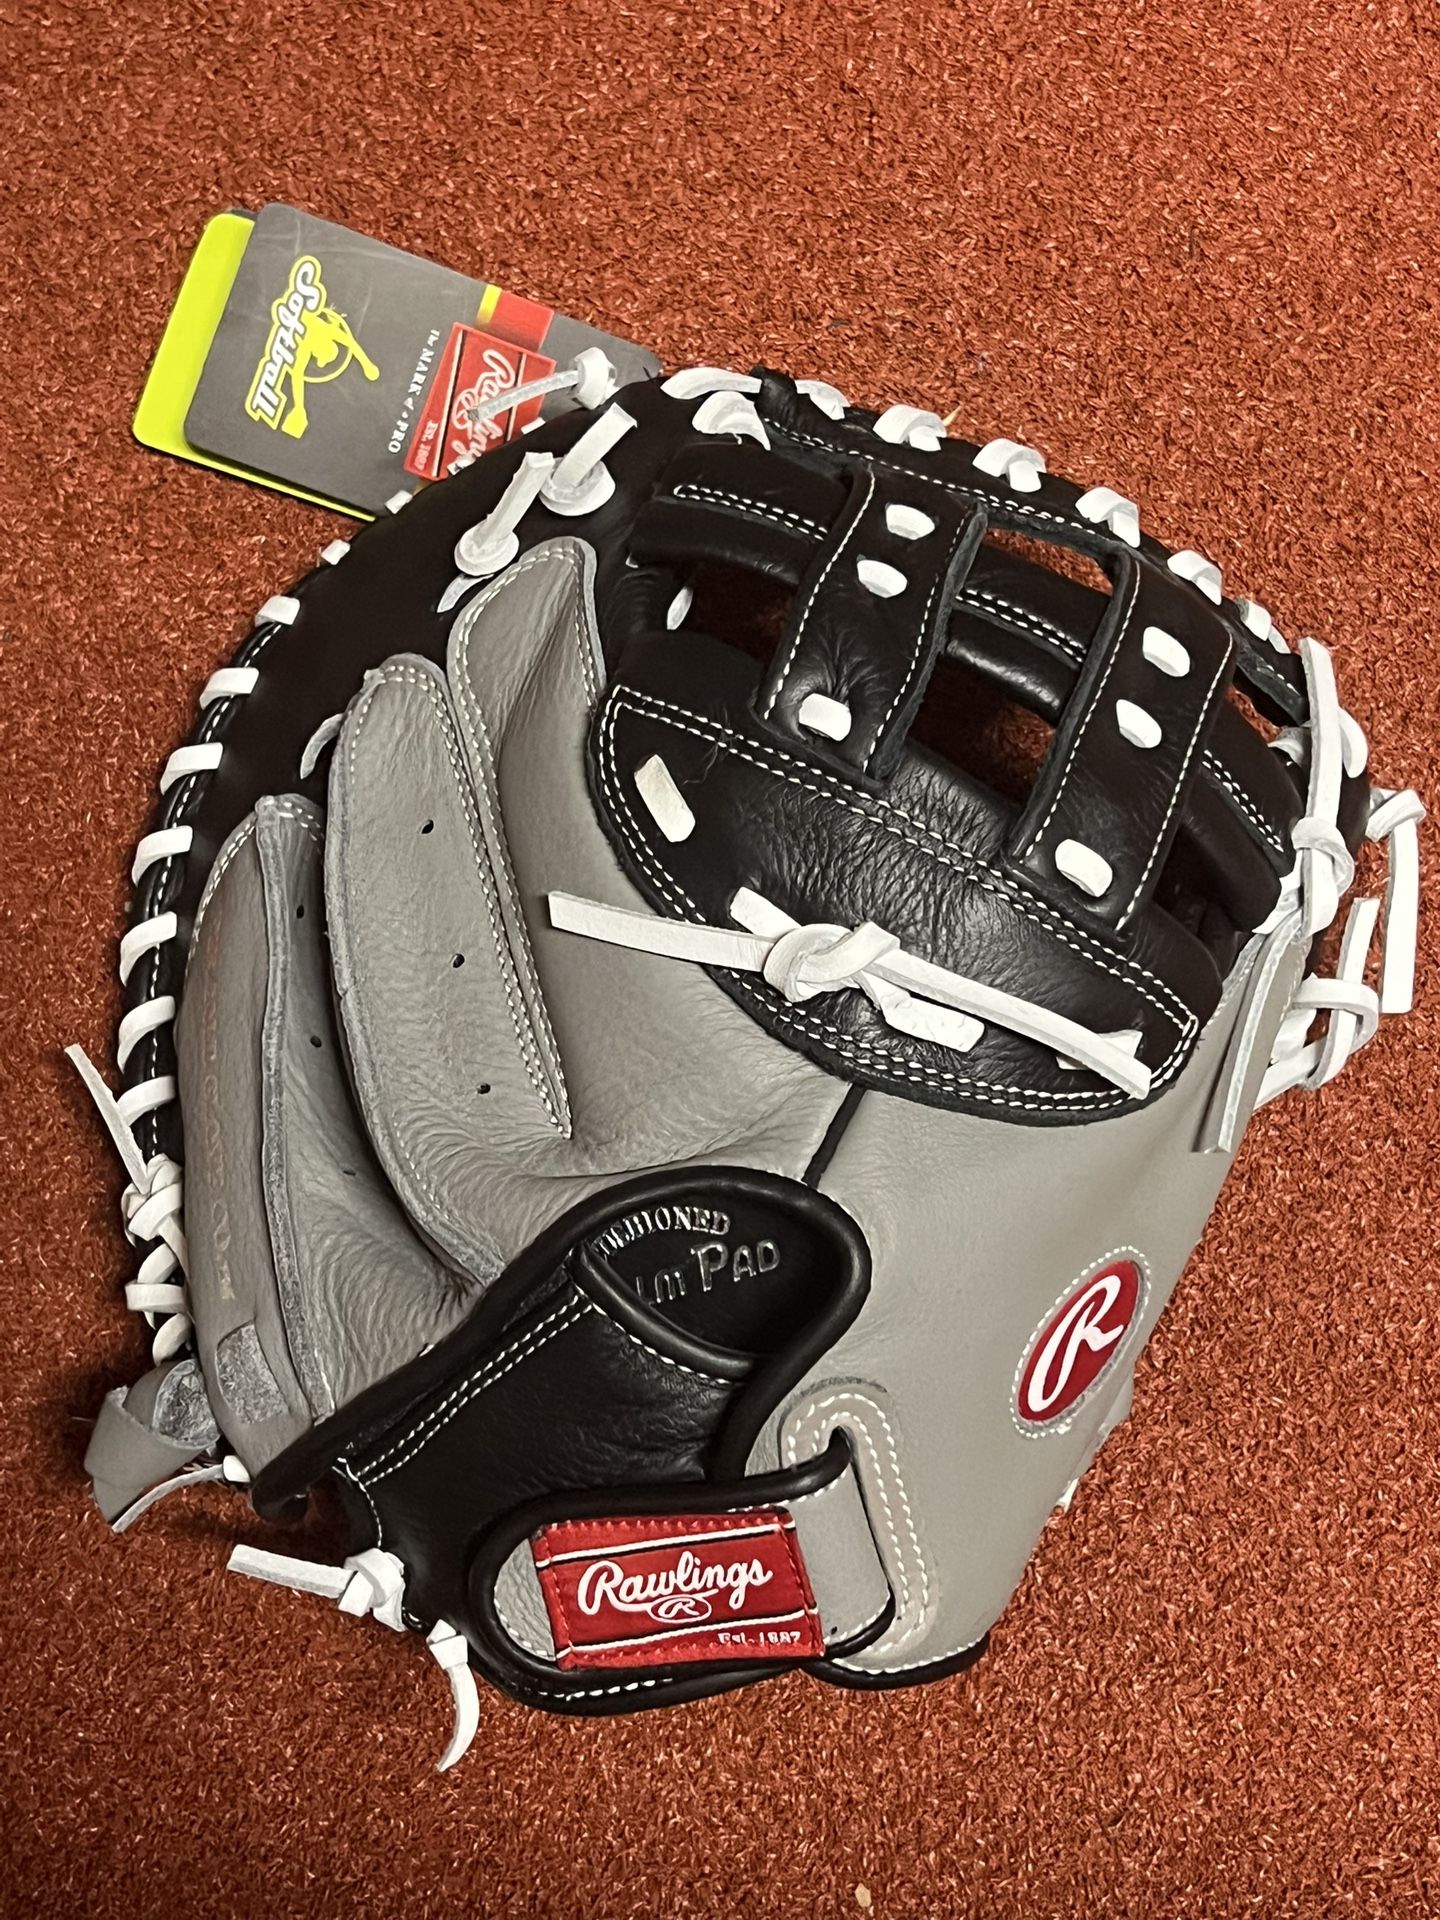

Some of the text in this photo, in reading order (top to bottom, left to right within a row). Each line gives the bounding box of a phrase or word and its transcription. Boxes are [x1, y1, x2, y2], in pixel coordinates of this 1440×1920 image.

[251, 261, 321, 419] Softball
[408, 347, 435, 396] MARK
[388, 419, 409, 454] PRO
[451, 349, 516, 463] Raling
[1027, 1274, 1125, 1413] R
[577, 1551, 774, 1615] Rawlings
[759, 1631, 801, 1646] 1887
